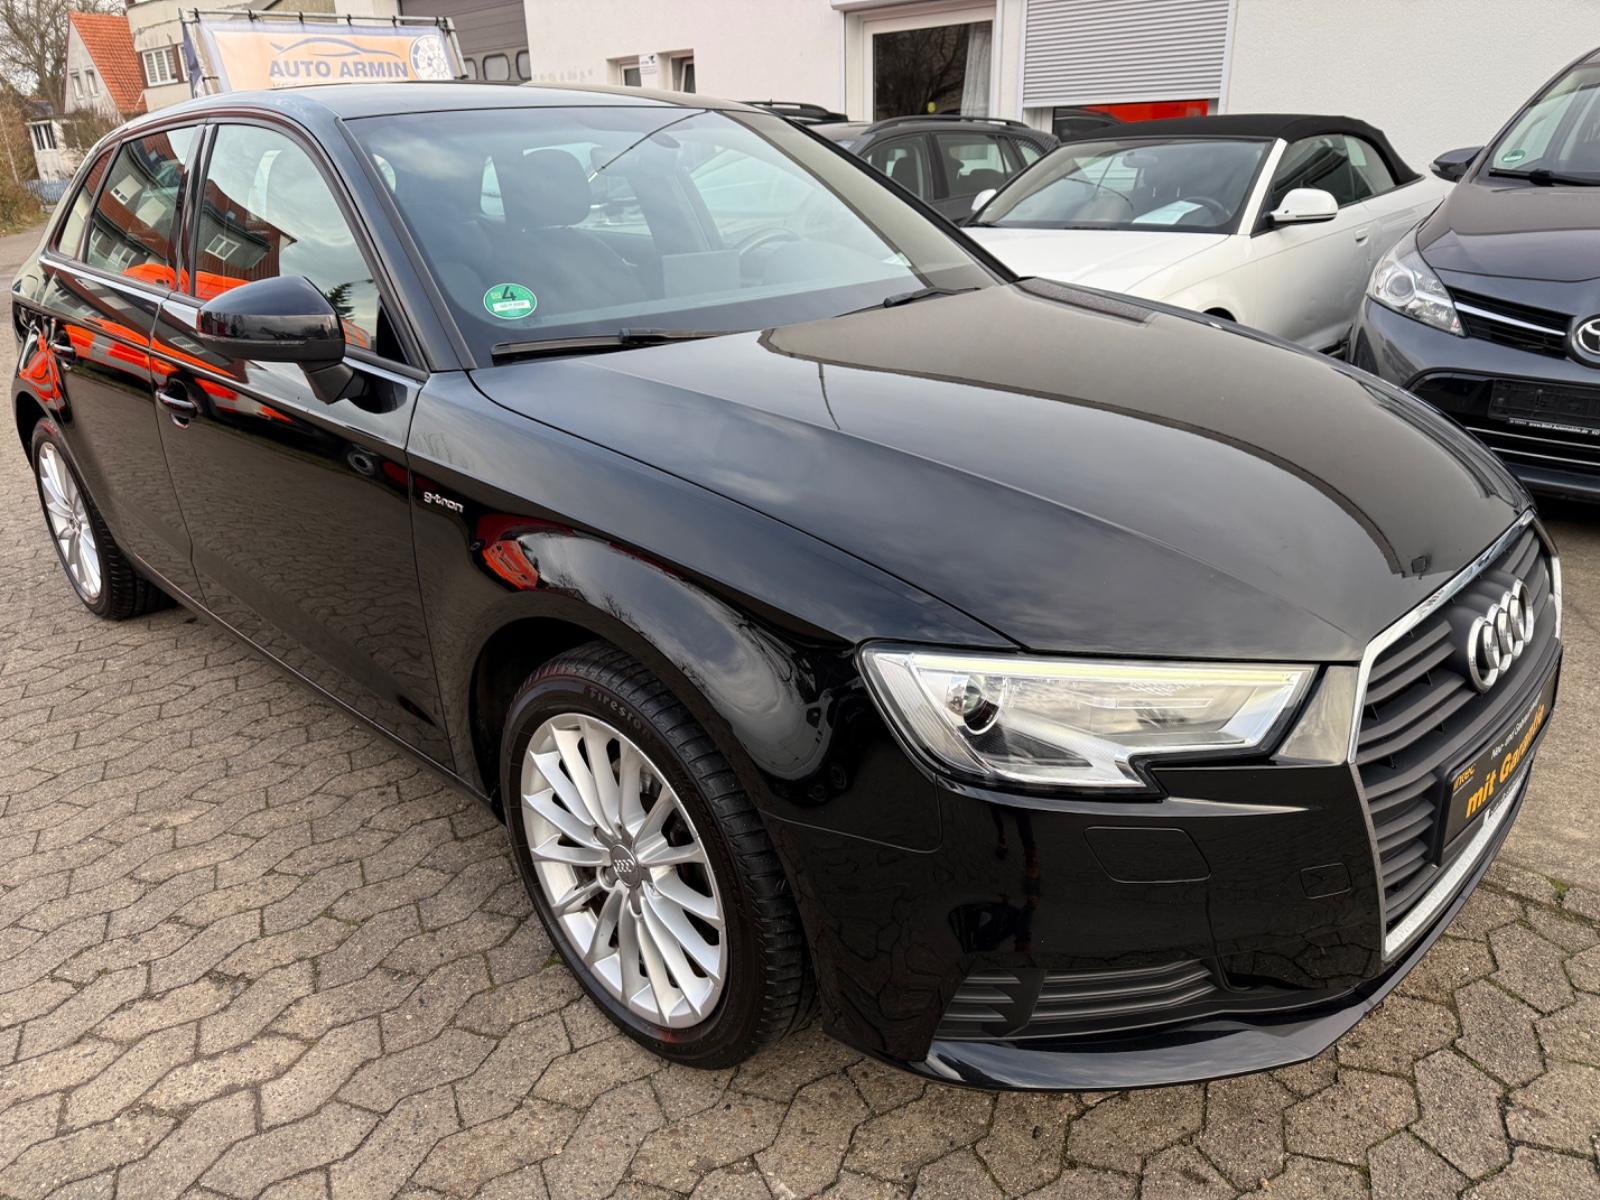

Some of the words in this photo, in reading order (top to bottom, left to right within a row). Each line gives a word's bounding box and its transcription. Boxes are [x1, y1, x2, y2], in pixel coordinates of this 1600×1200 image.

[270, 61, 331, 77] AUTO
[340, 62, 408, 77] ARMIN
[502, 286, 517, 300] 4
[424, 491, 464, 513] g-tron
[1466, 769, 1497, 818] mit
